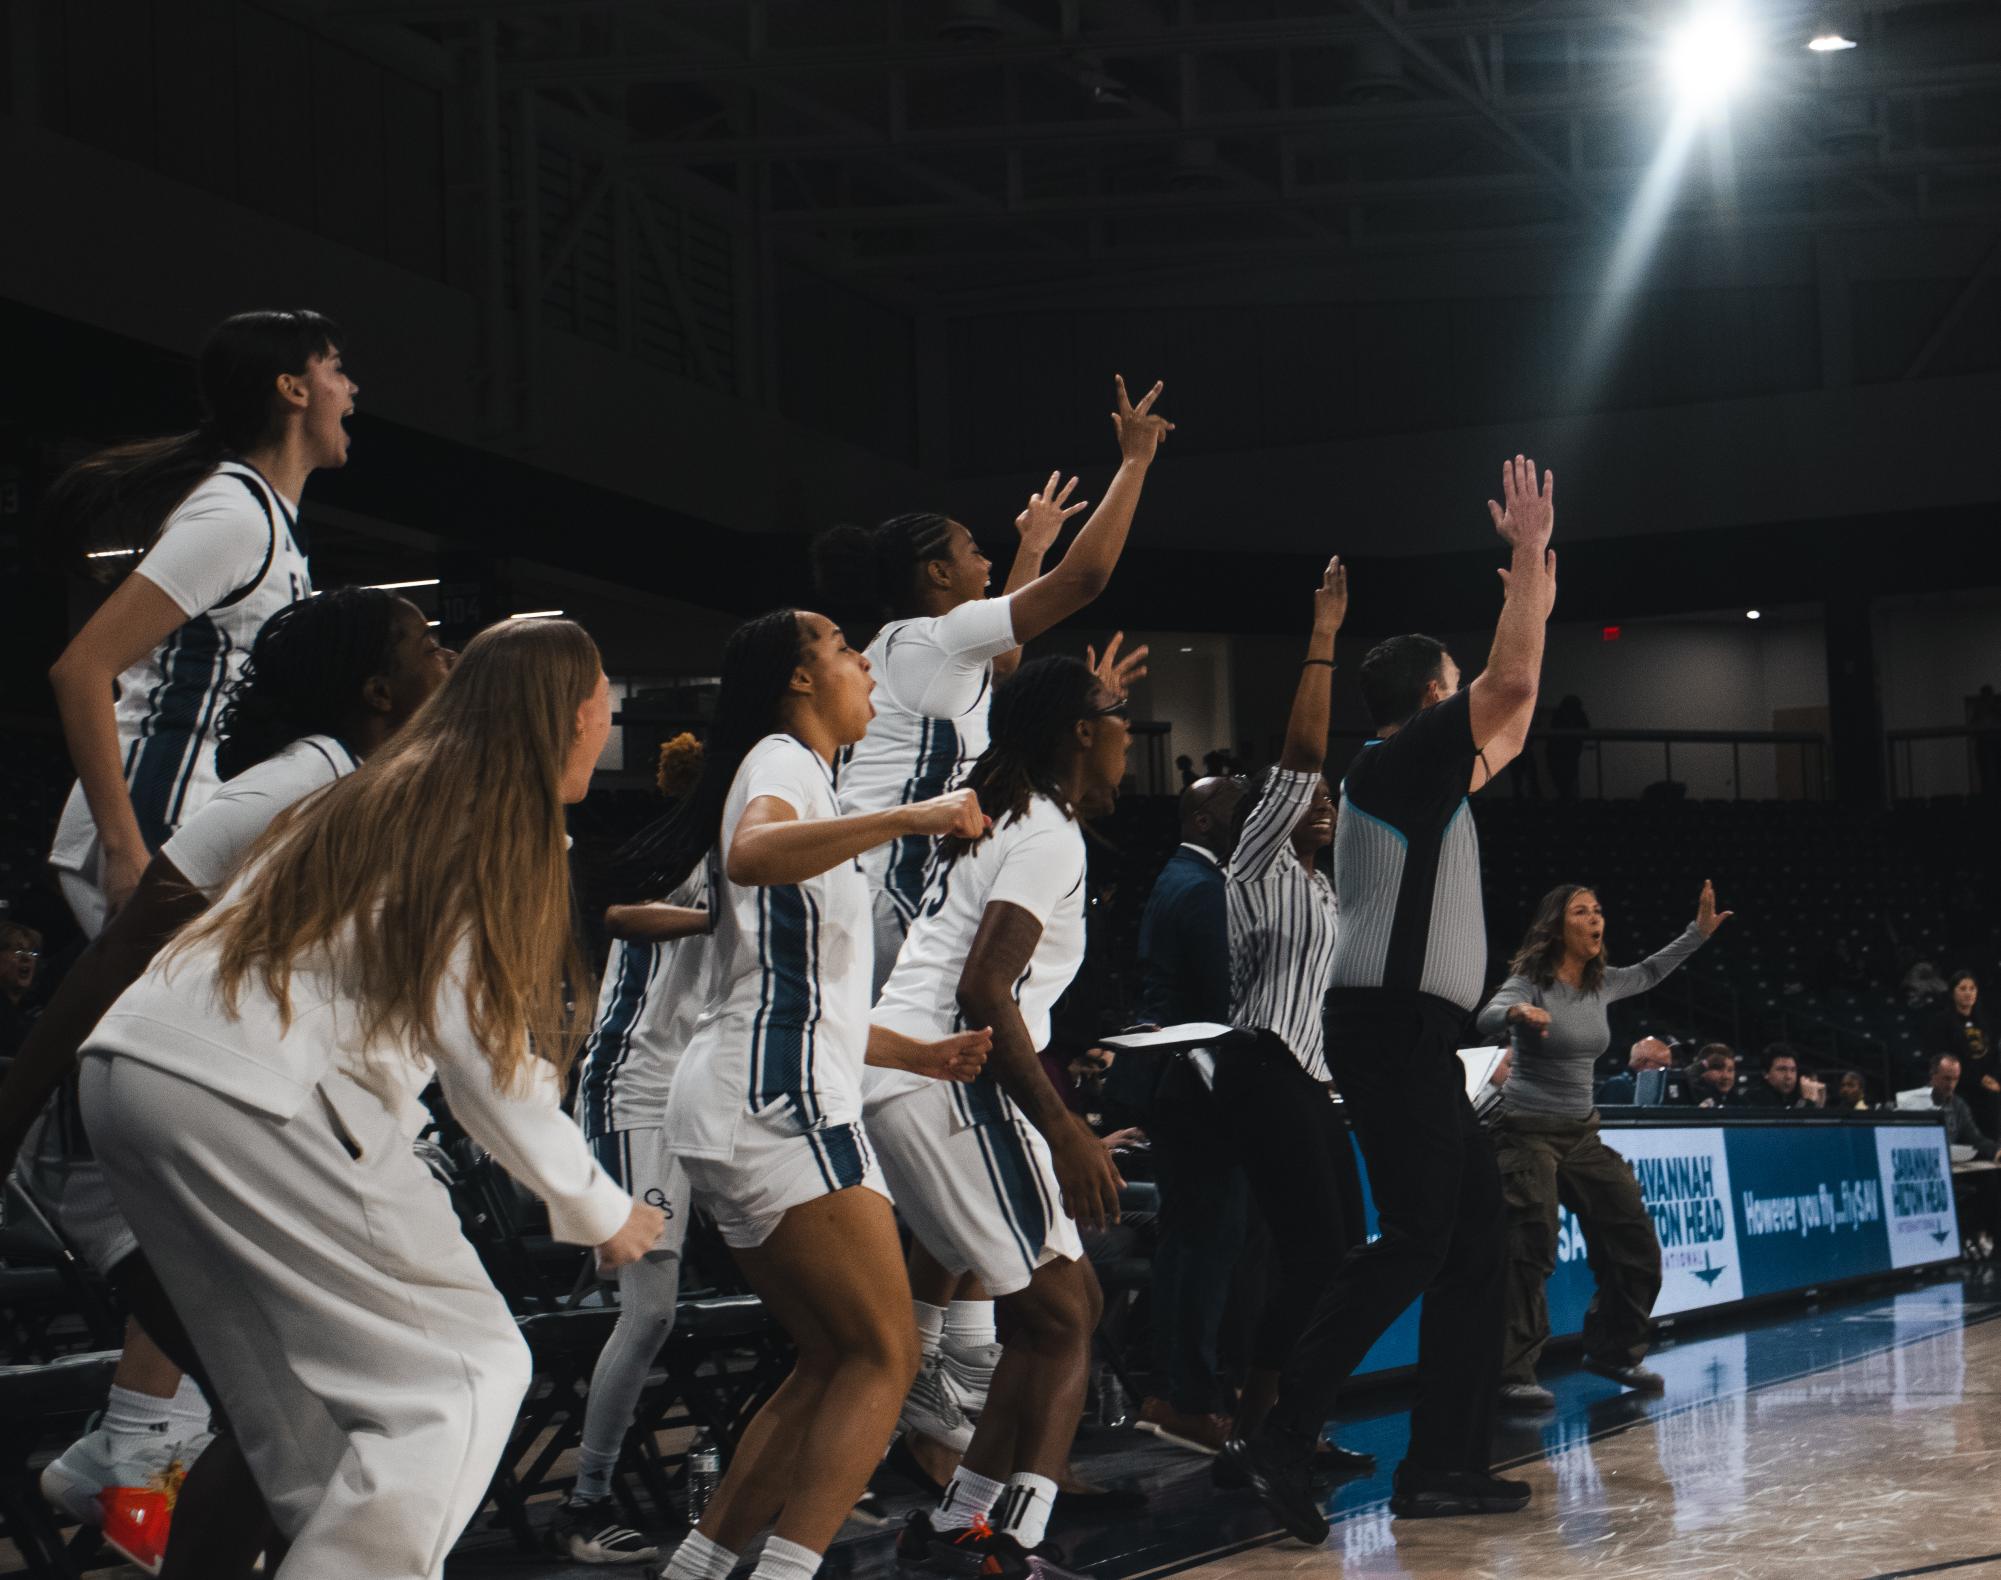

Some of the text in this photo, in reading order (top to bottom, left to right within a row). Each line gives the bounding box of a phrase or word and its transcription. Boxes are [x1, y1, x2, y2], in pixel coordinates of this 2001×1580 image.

[1627, 1157, 1714, 1202] AVANNAH
[1684, 1199, 1725, 1245] HEAD
[1743, 1191, 1798, 1235] However
[1797, 1195, 1821, 1238] you
